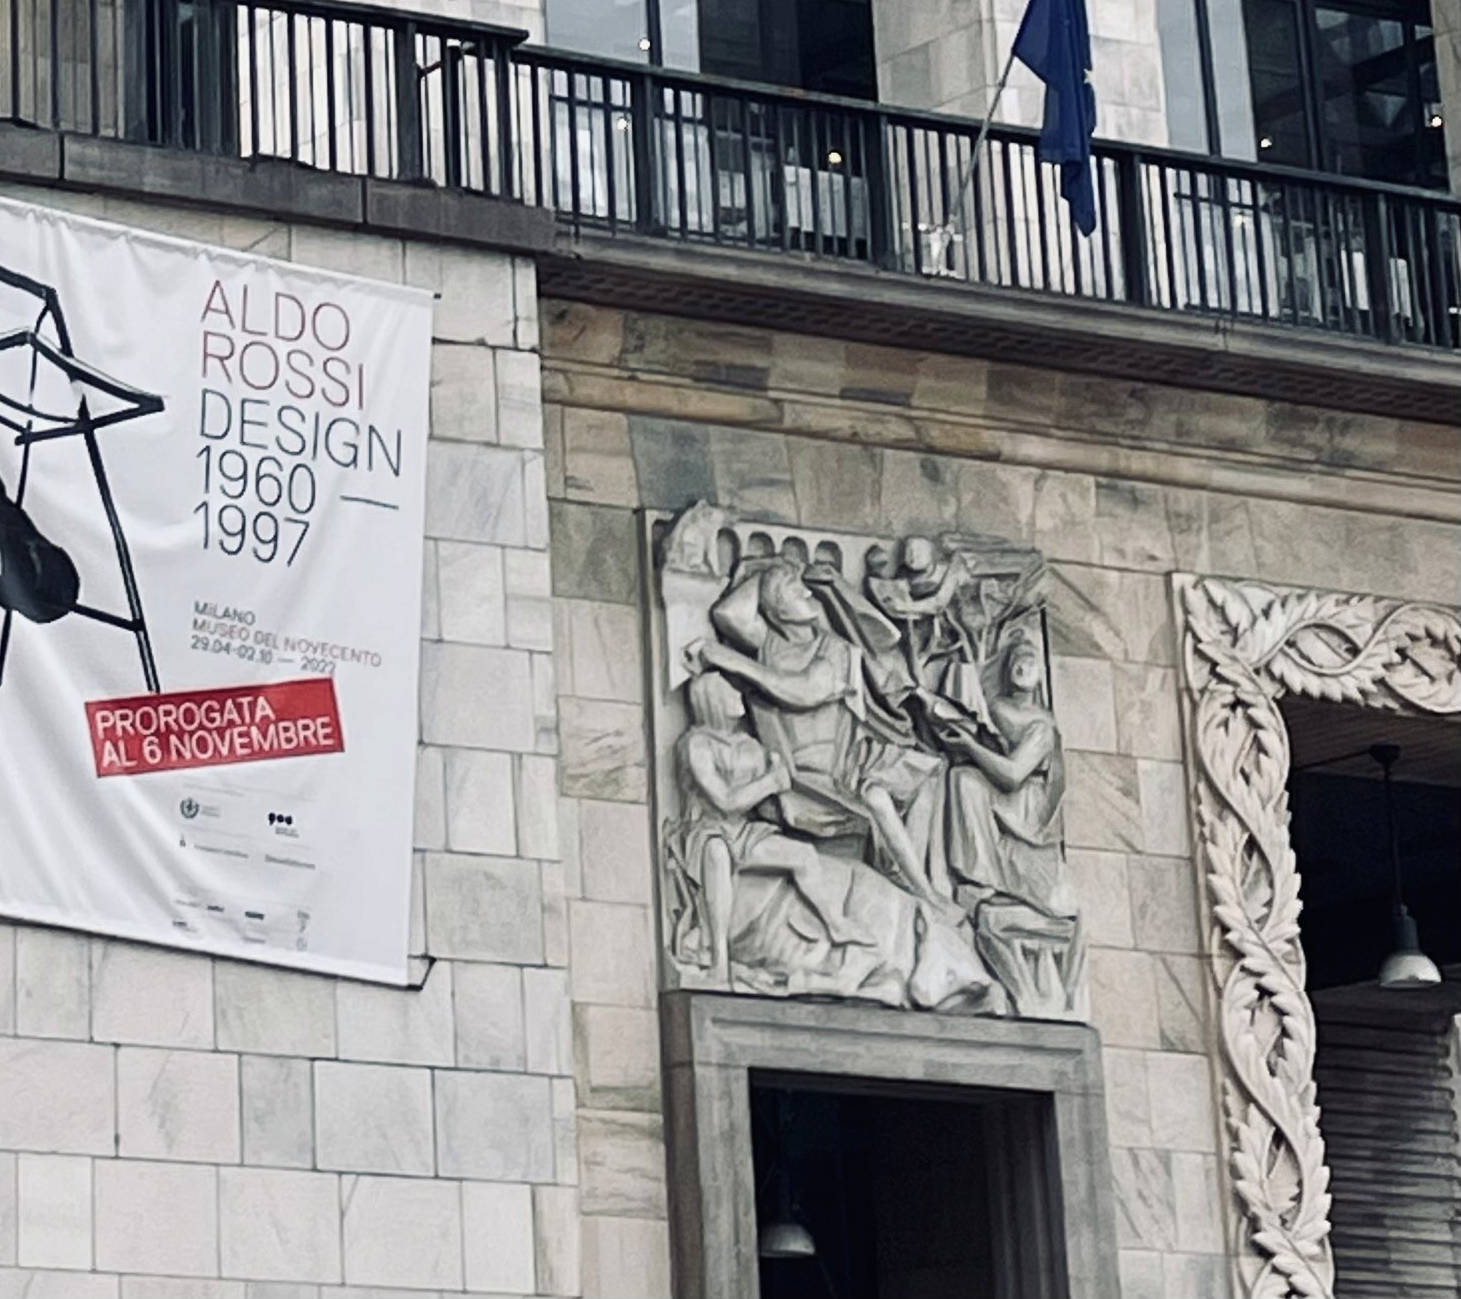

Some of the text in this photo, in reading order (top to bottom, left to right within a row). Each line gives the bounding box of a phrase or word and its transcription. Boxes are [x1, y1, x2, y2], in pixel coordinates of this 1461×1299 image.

[200, 280, 350, 351] ALDO
[202, 330, 364, 410] ROSSI
[200, 387, 402, 477] DESIGN
[195, 445, 316, 514] 1960
[193, 500, 310, 567] 1997
[193, 618, 382, 668] MUSEO DEL NOVECENTO
[195, 600, 256, 626] MILANO
[95, 696, 275, 740] PROROGATA
[101, 716, 335, 768] AL 6 NOVEMBRE
